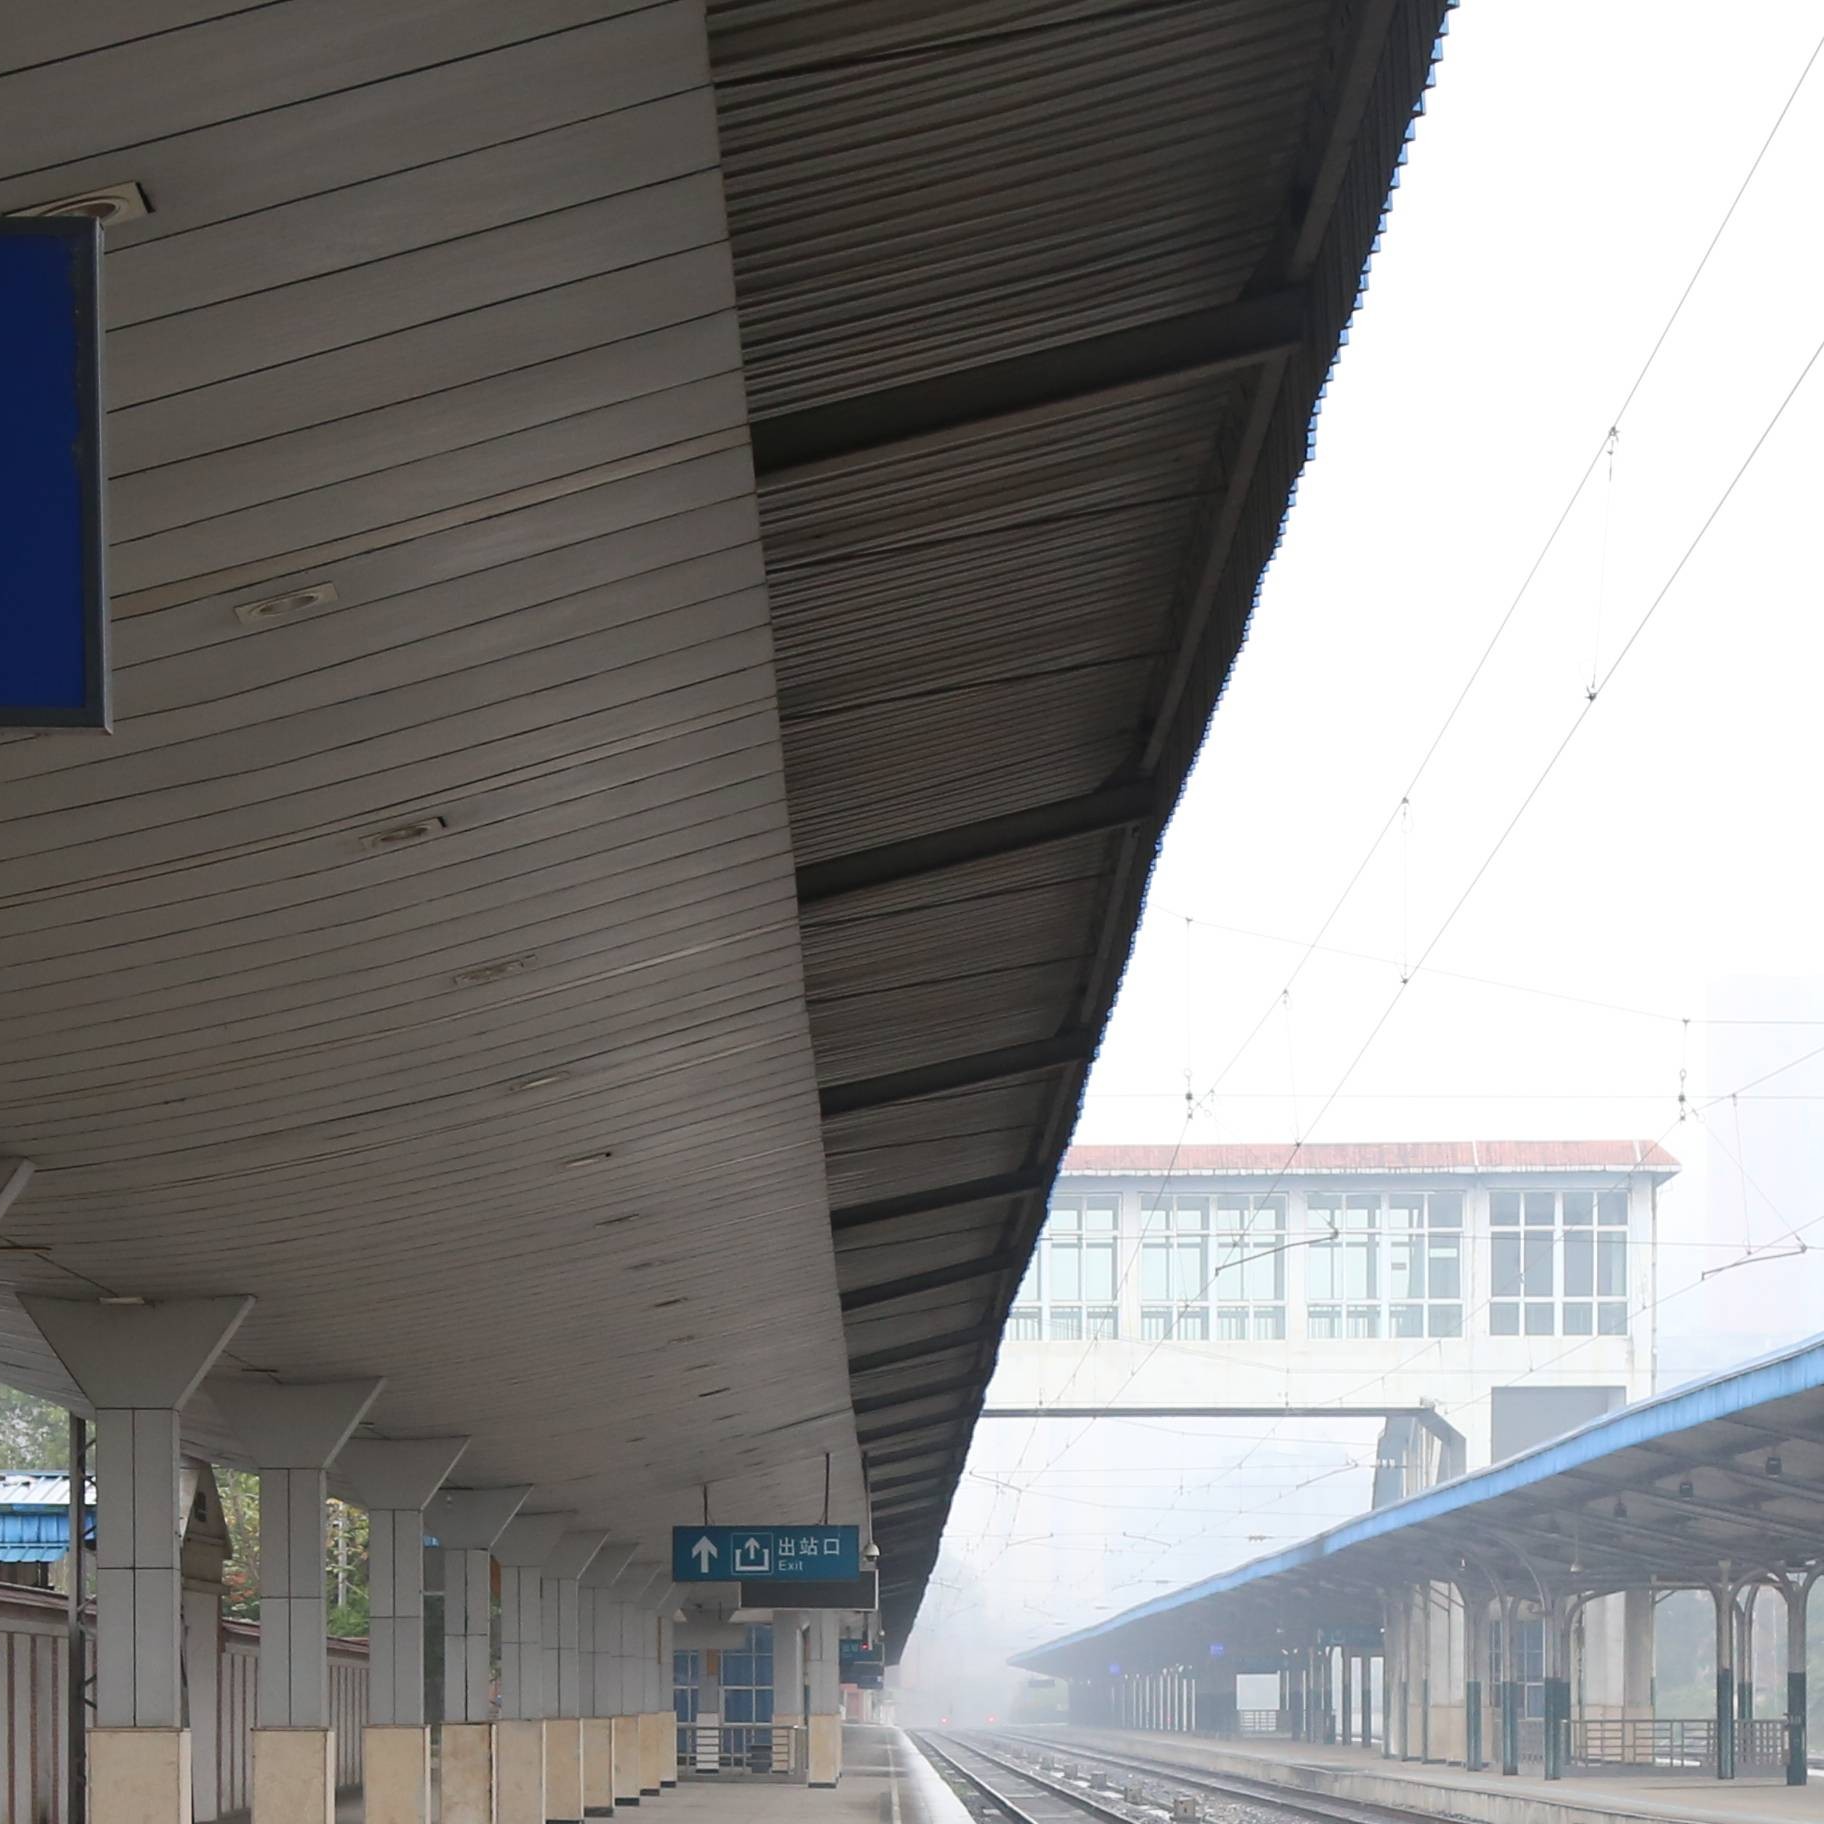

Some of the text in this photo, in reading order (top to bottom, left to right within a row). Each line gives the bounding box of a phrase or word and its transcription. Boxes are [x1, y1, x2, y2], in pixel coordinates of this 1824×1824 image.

[778, 1536, 840, 1556] 出站口
[778, 1560, 803, 1571] Exit
